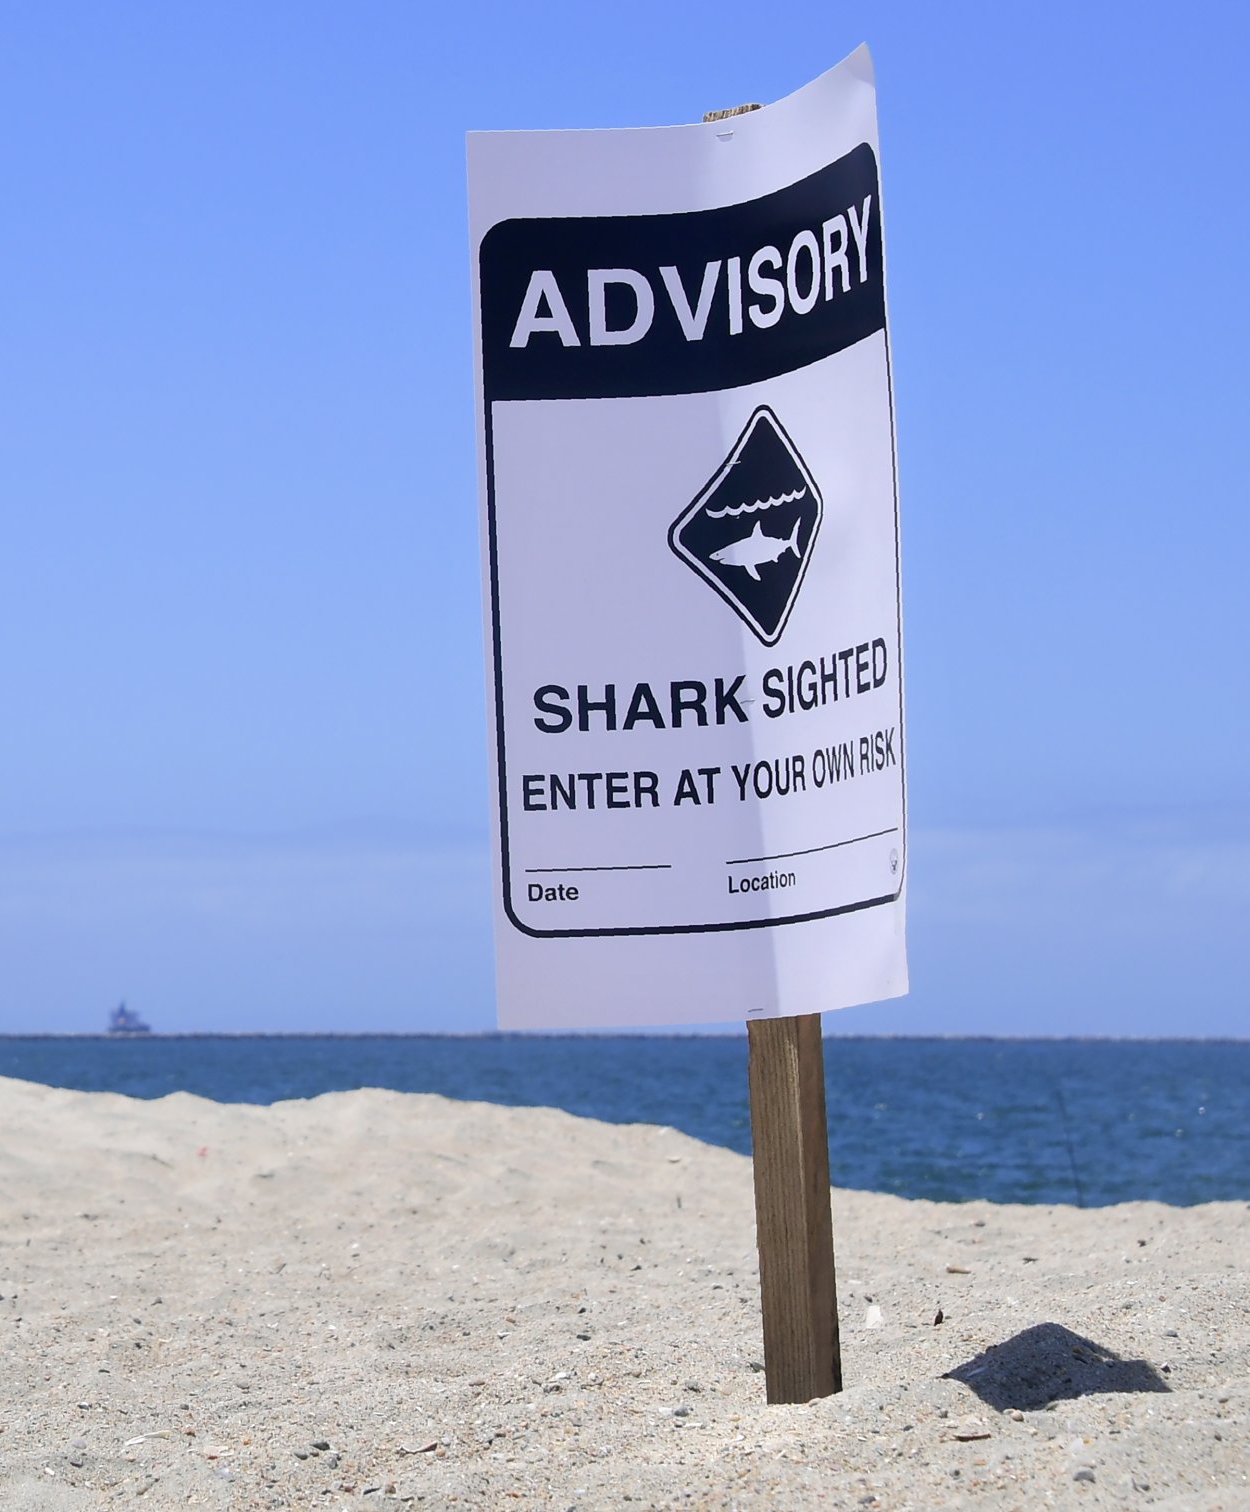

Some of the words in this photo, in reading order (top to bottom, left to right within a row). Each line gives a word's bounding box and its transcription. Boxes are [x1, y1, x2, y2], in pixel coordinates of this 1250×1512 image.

[509, 194, 872, 348] ADVISORY
[533, 674, 750, 734] SHARK
[762, 637, 888, 719] SIGHTED
[522, 770, 661, 812] ENTER
[673, 766, 722, 807] AT
[731, 754, 807, 802] YOUR
[812, 740, 855, 789] OWN
[859, 727, 896, 776] RISK
[527, 883, 580, 902] Date
[727, 871, 796, 895] Location
